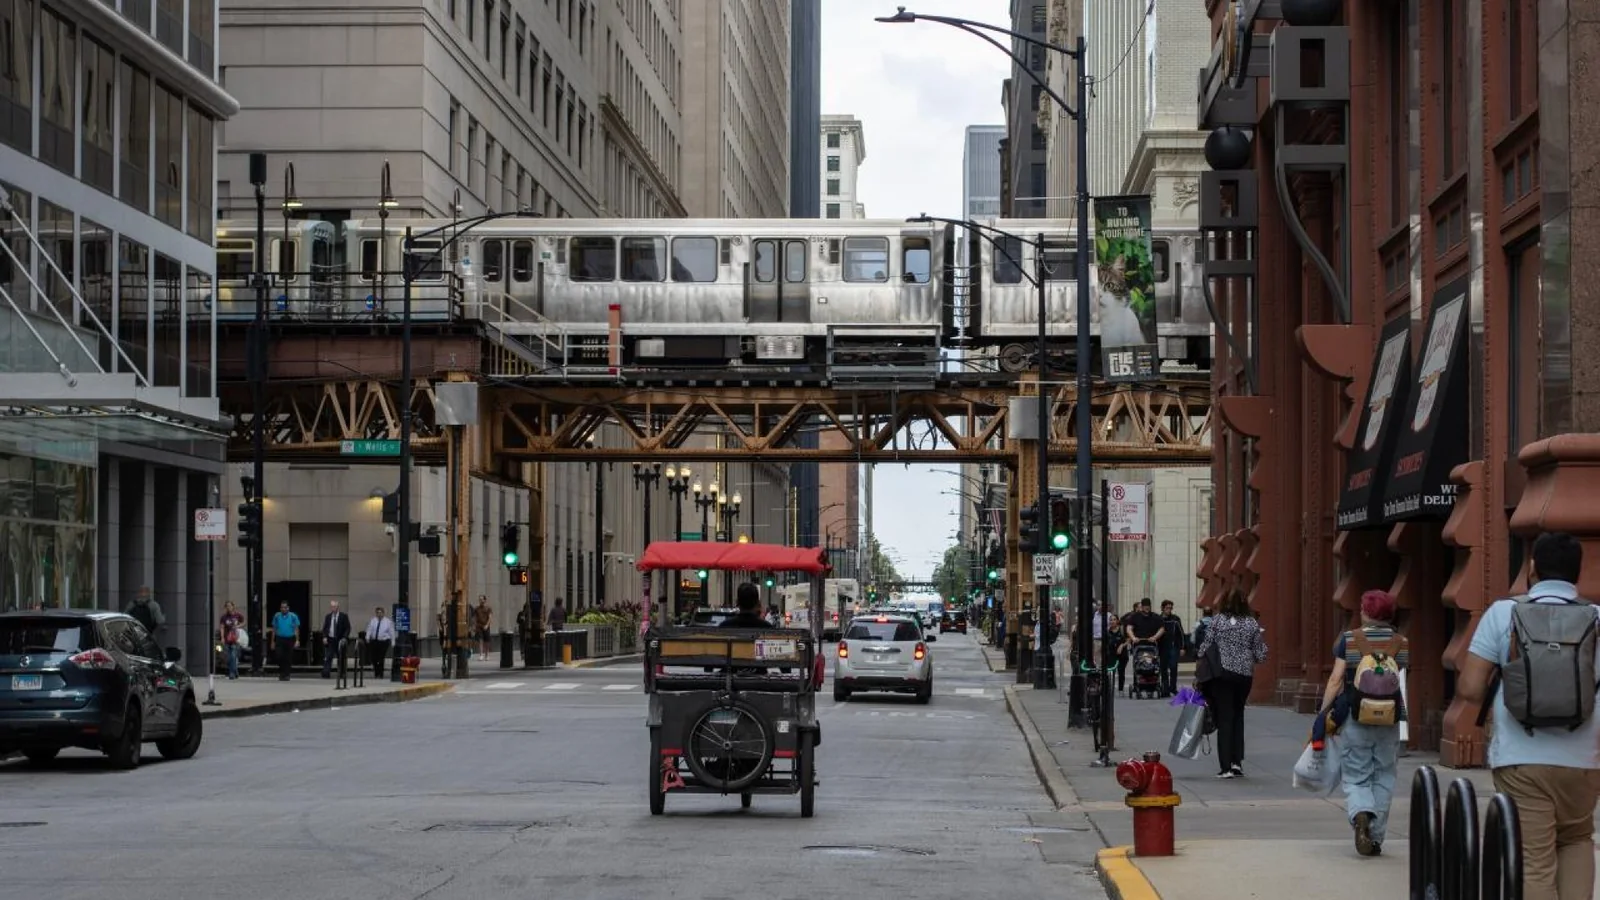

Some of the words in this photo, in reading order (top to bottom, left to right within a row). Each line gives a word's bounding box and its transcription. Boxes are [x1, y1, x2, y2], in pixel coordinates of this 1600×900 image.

[1117, 207, 1128, 217] TO
[1106, 217, 1140, 228] RULING
[1101, 229, 1122, 239] YOUR
[1035, 556, 1053, 564] ONE
[521, 571, 528, 583] 6
